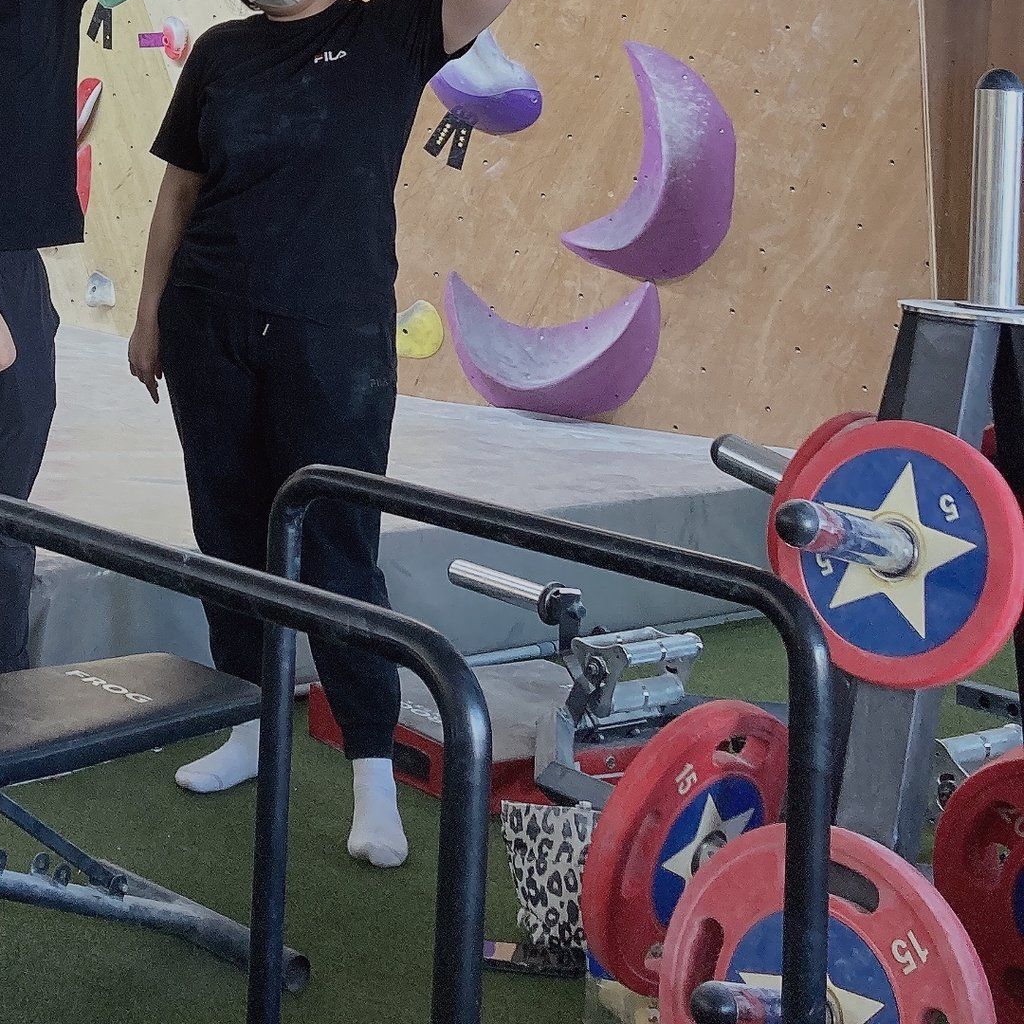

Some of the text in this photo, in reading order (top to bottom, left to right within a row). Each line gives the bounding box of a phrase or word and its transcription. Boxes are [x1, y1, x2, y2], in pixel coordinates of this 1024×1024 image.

[314, 50, 347, 63] FILA
[939, 494, 960, 522] 5
[64, 669, 153, 703] FROG
[675, 762, 697, 795] 15
[891, 929, 929, 975] 15
